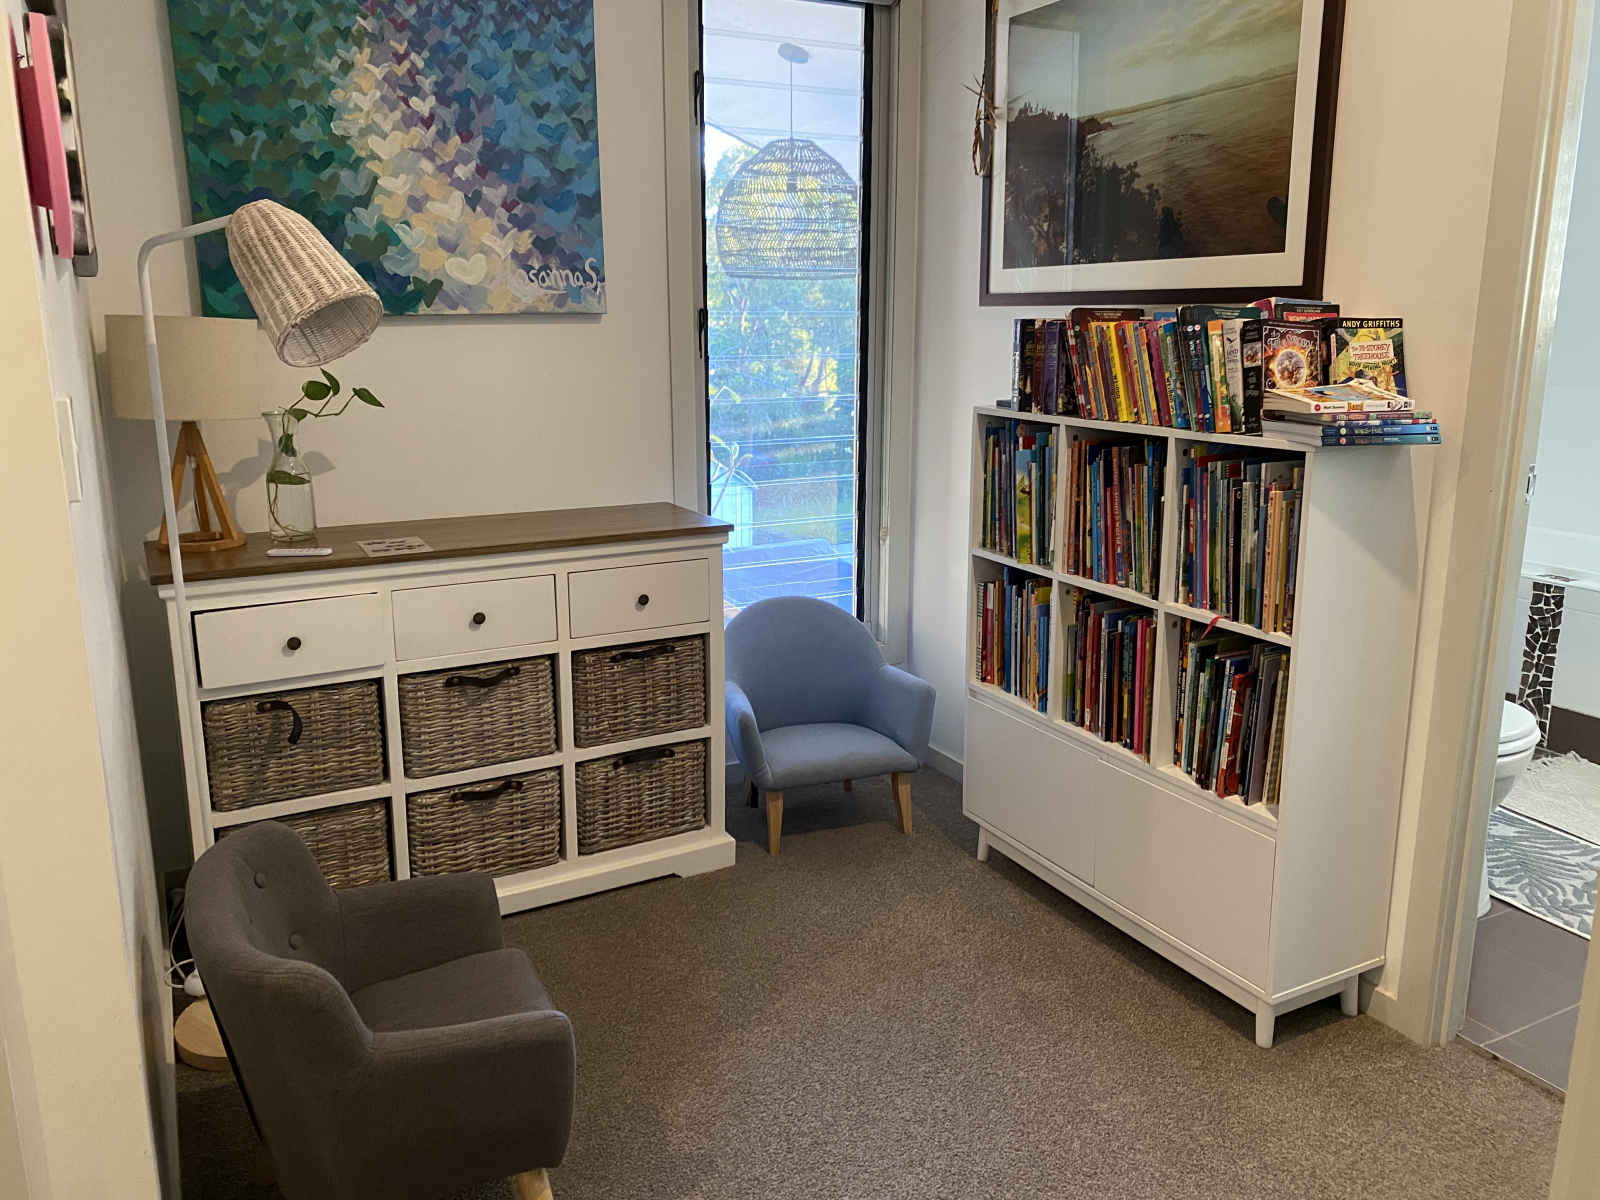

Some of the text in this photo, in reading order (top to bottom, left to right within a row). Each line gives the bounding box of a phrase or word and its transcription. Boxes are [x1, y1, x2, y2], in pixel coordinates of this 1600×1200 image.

[1342, 320, 1400, 328] ANDY GRIFFITHS
[1353, 352, 1389, 361] TREEHOUSE
